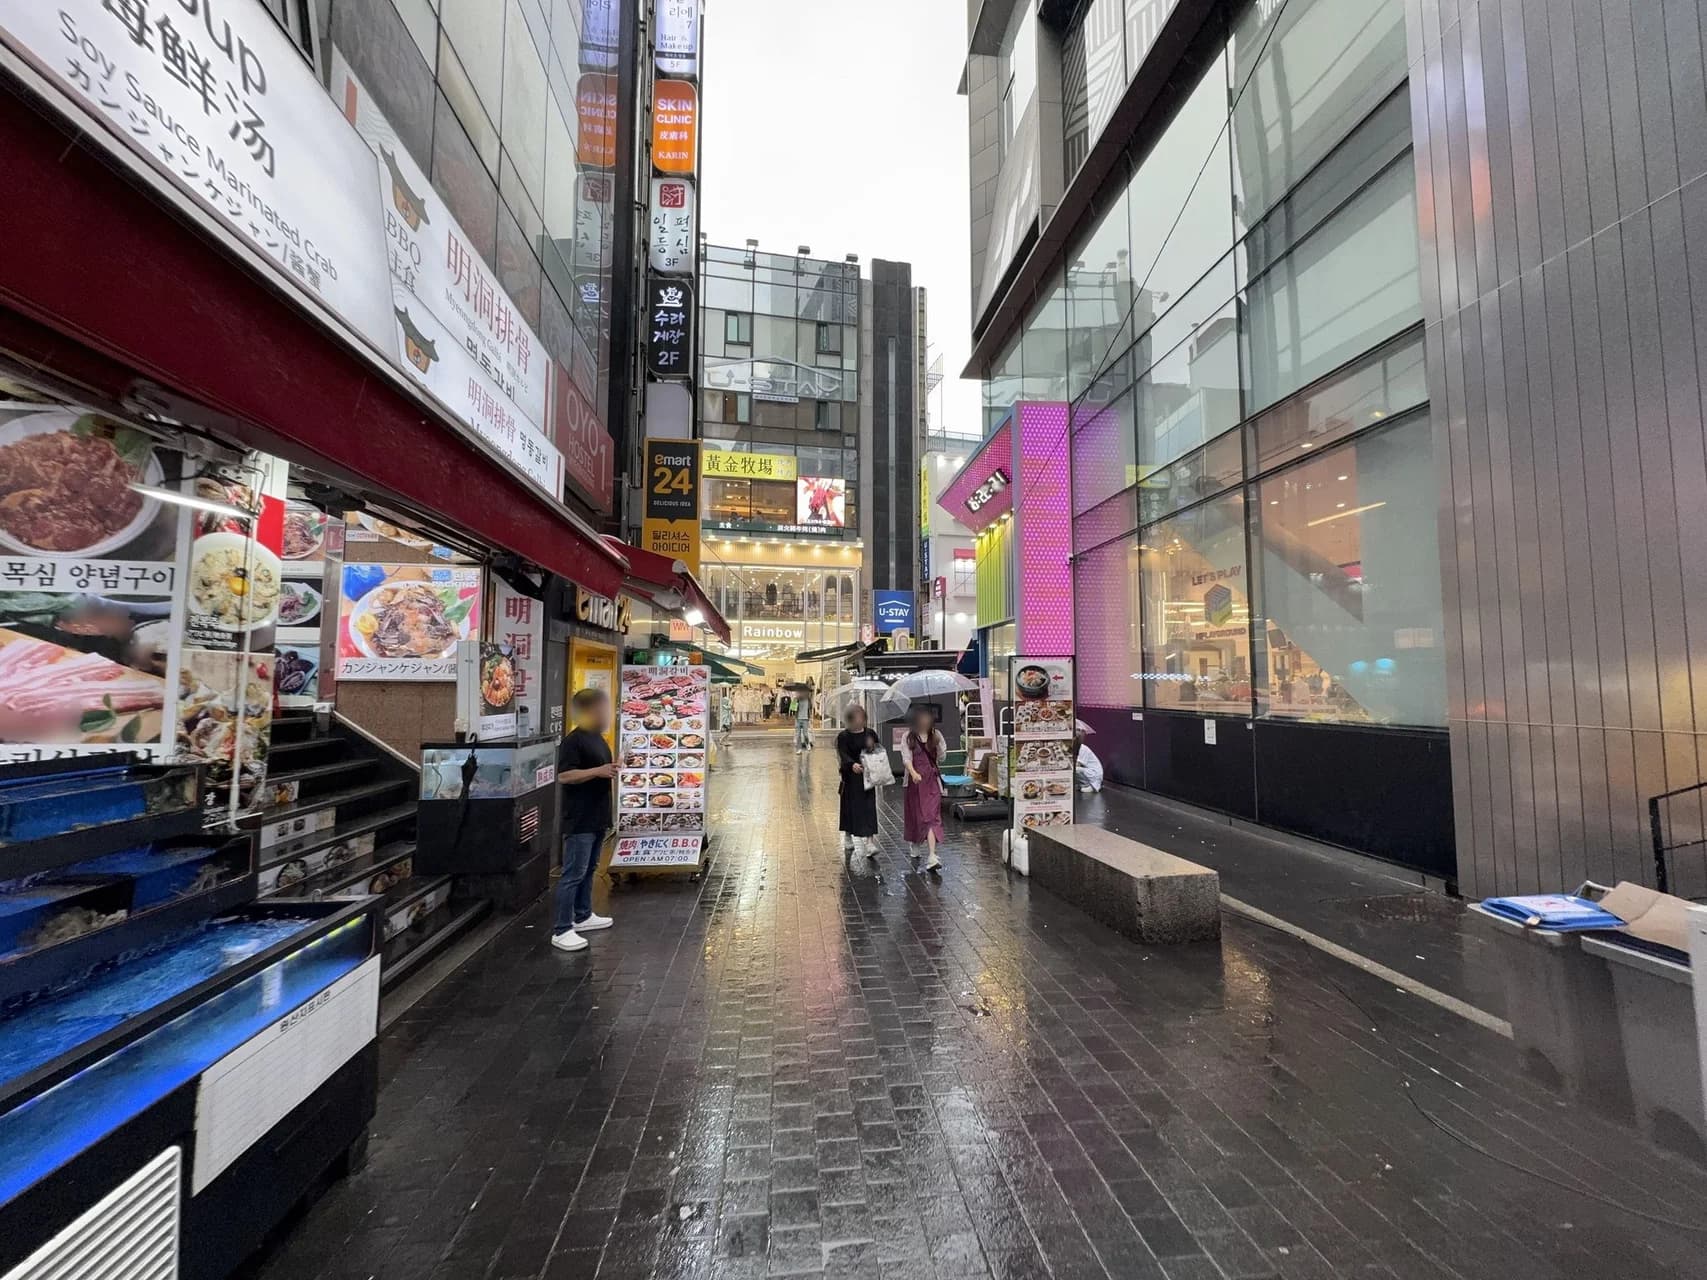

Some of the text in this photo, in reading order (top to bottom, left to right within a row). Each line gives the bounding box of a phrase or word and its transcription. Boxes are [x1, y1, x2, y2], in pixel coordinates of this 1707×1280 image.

[660, 33, 678, 41] Hair
[660, 42, 694, 51] Makeup
[657, 100, 693, 112] SKIN
[656, 114, 693, 124] CLINIC
[58, 9, 339, 281] Soy Sauce Marinated Crab
[658, 151, 689, 160] KARIN
[385, 208, 422, 273] BBQ
[664, 257, 679, 267] 3F
[447, 229, 531, 376] 明洞排骨
[654, 310, 686, 327] 수라
[658, 351, 680, 365] 2F
[468, 375, 518, 445] 明洞排骨
[567, 390, 600, 457] OYO
[568, 437, 597, 479] HOSTEL
[654, 454, 692, 467] emart
[653, 467, 692, 495] 24
[652, 530, 690, 541] 딜리셔스
[652, 542, 690, 553] 아이디어
[2, 561, 176, 592] 목심 양념구이
[1192, 565, 1241, 586] LET'S PLAY
[879, 608, 910, 617] U-STAY
[743, 626, 803, 639] Rainbow
